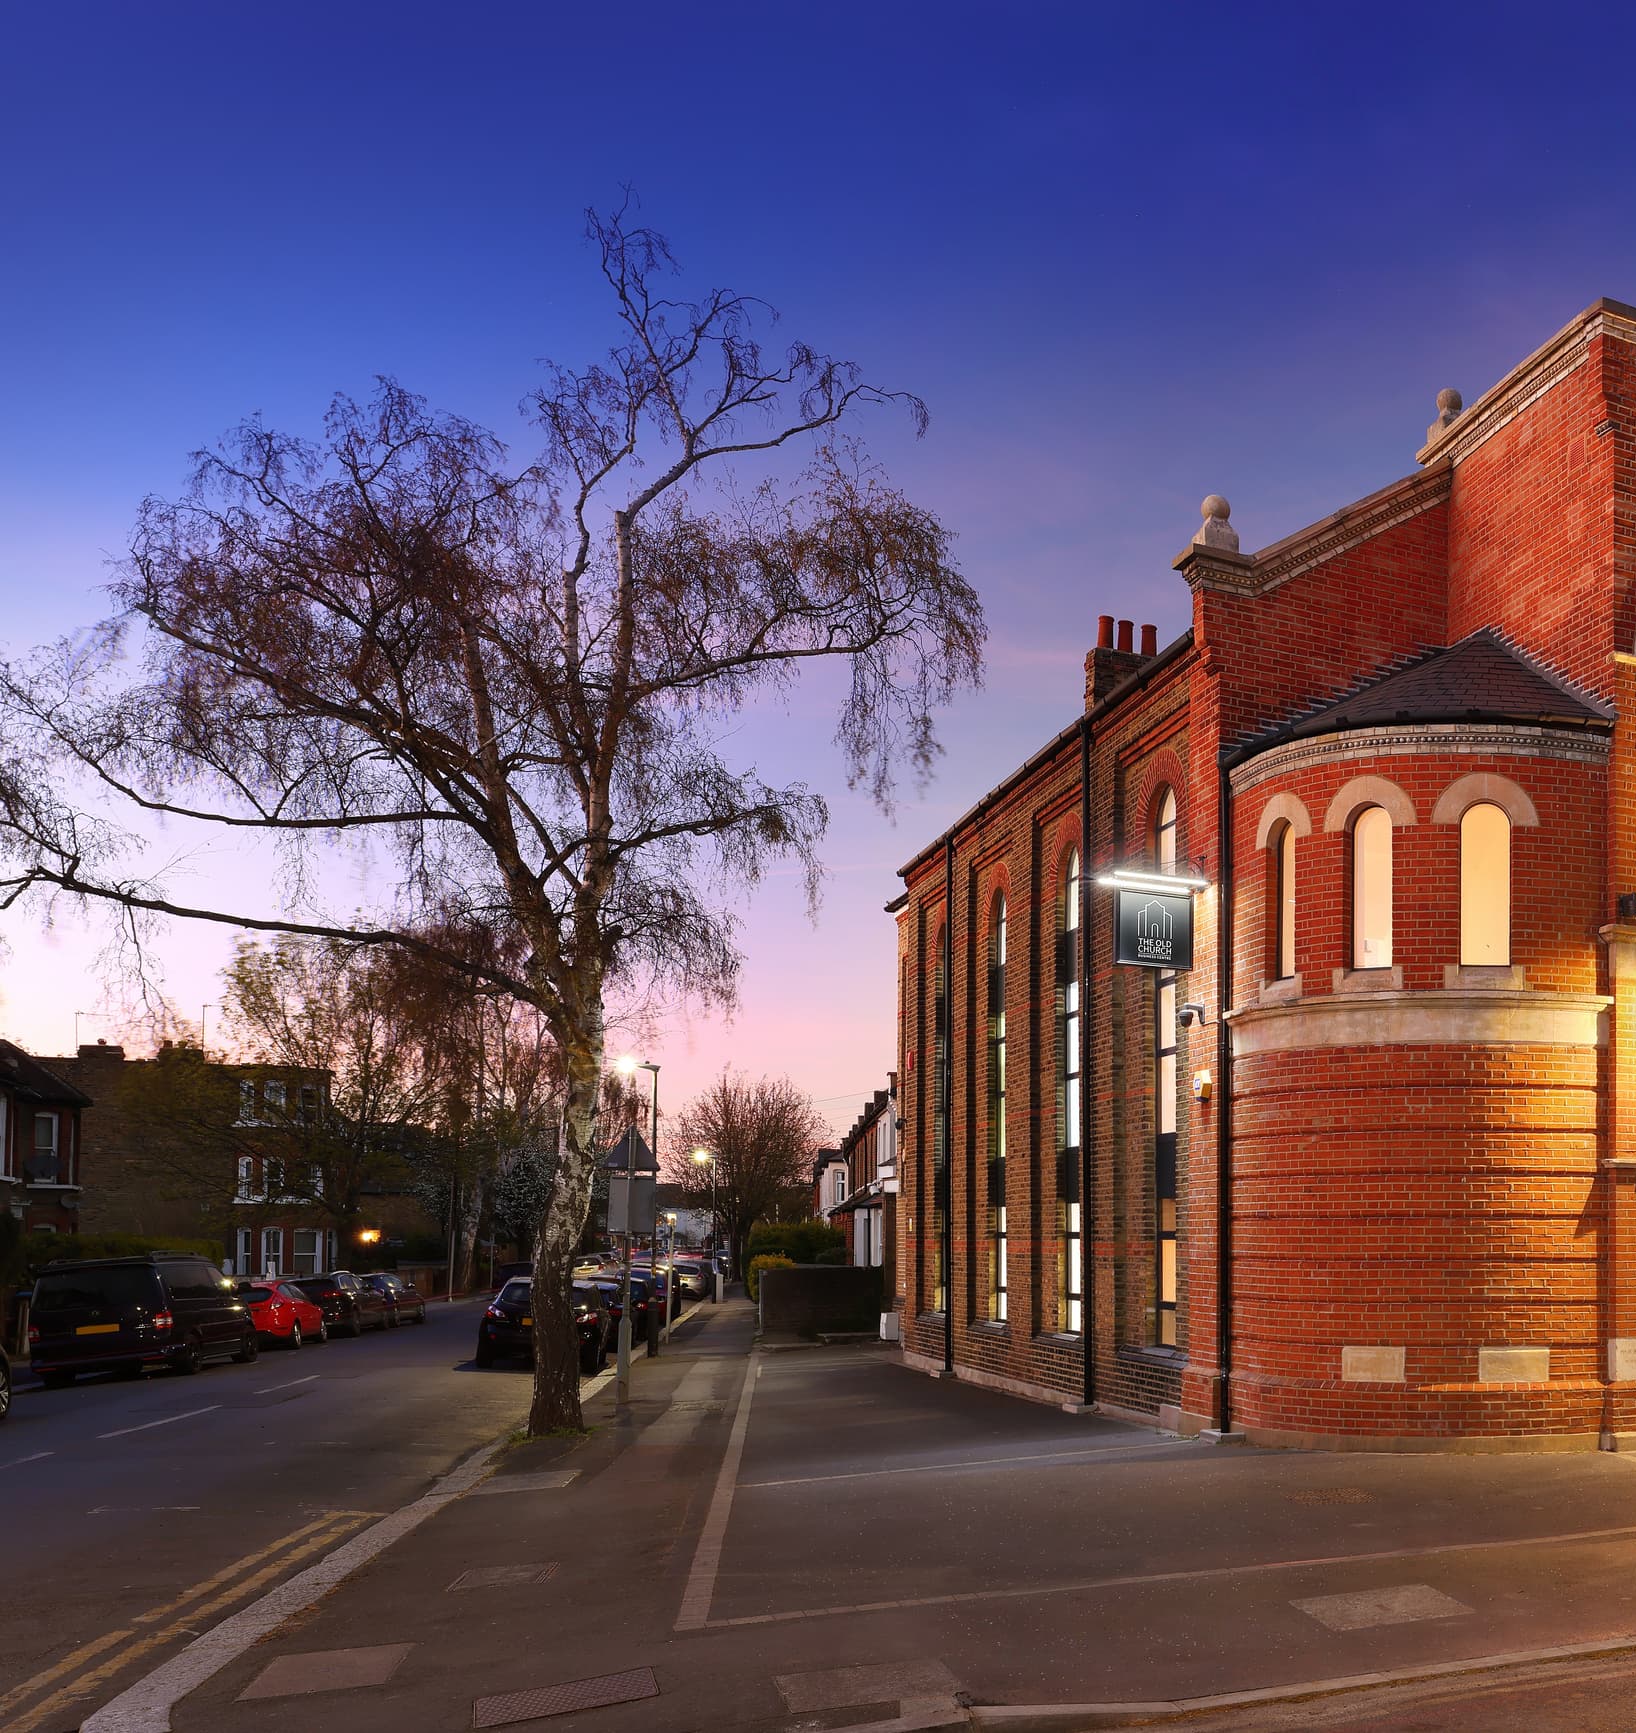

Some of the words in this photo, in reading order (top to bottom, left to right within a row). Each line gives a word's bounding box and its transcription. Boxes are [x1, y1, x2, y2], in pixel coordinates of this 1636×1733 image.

[1138, 937, 1154, 946] THE
[1155, 939, 1172, 948] OLD
[1138, 945, 1172, 955] CHURCH
